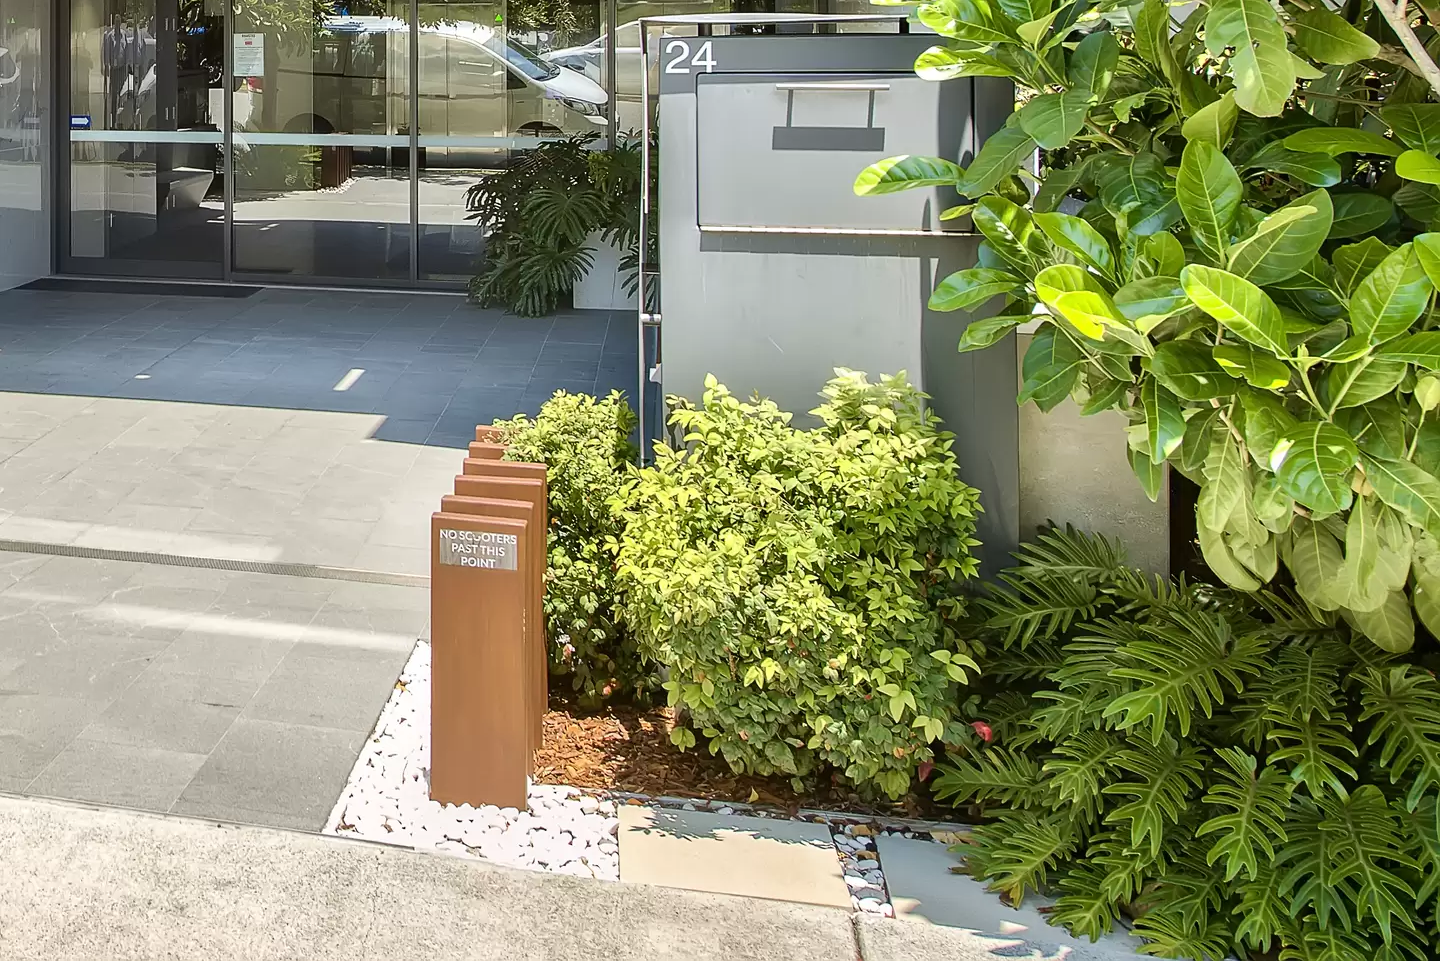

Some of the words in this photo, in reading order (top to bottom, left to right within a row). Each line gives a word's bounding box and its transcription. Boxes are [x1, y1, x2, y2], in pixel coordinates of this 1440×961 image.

[664, 40, 718, 74] 24
[440, 529, 458, 540] NO
[451, 542, 479, 555] PAST
[479, 544, 506, 557] THIS
[460, 556, 497, 569] POINT
